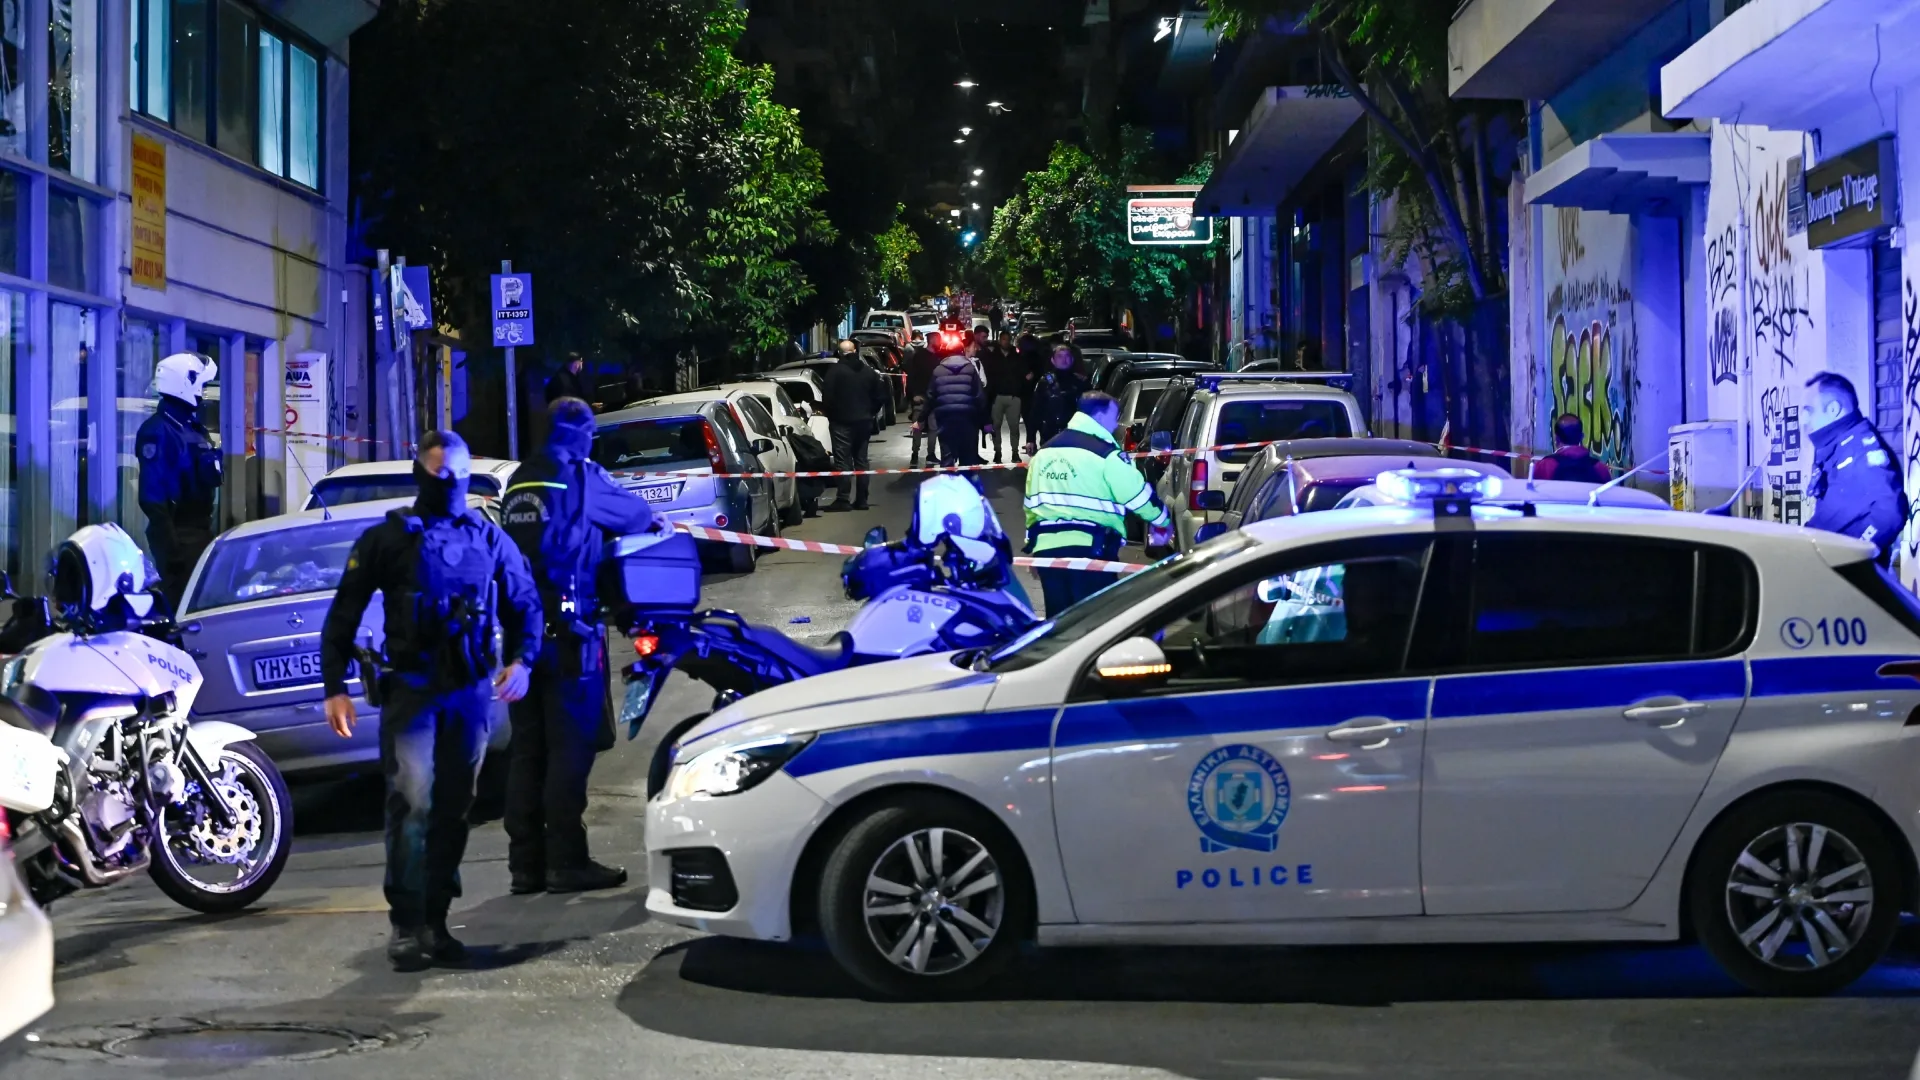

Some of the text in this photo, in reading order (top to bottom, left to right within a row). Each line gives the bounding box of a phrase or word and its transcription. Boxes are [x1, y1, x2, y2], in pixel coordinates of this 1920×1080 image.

[1807, 186, 1843, 225] Boutique
[1046, 472, 1068, 481] POLICE
[509, 511, 538, 523] POLICE
[1816, 616, 1867, 647] 100
[147, 653, 193, 684] POLICE
[1190, 745, 1288, 826] ΕΛΛΗΝΙΚΗ ΑΣΤΥΝΟΜΙΑ
[1175, 863, 1313, 890] POLICE
